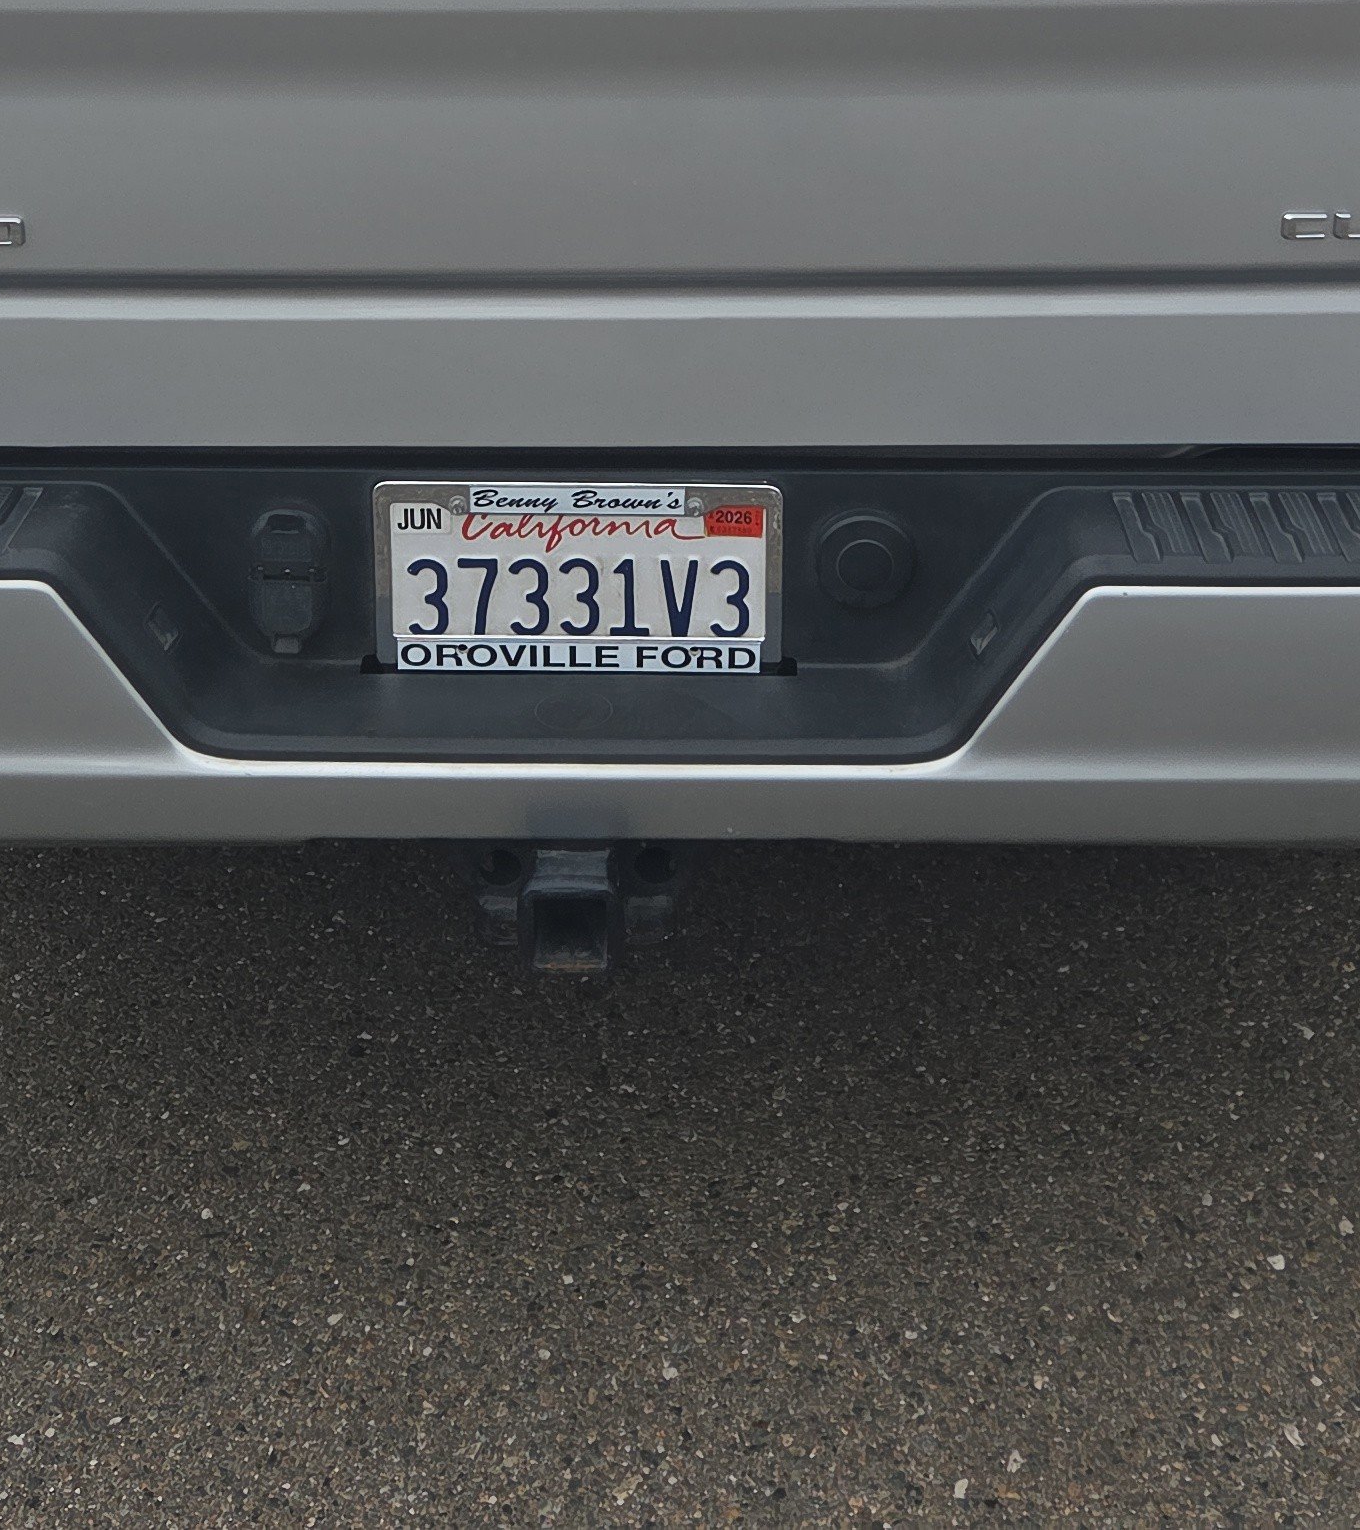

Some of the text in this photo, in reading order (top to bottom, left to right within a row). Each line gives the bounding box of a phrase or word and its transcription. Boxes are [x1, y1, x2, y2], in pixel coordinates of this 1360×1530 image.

[471, 488, 683, 512] Benny Brown's
[397, 507, 443, 531] JUN
[715, 509, 753, 525] 2026
[460, 512, 705, 554] California
[407, 558, 751, 636] 37331V3
[400, 643, 757, 670] OROVILLE FORD
